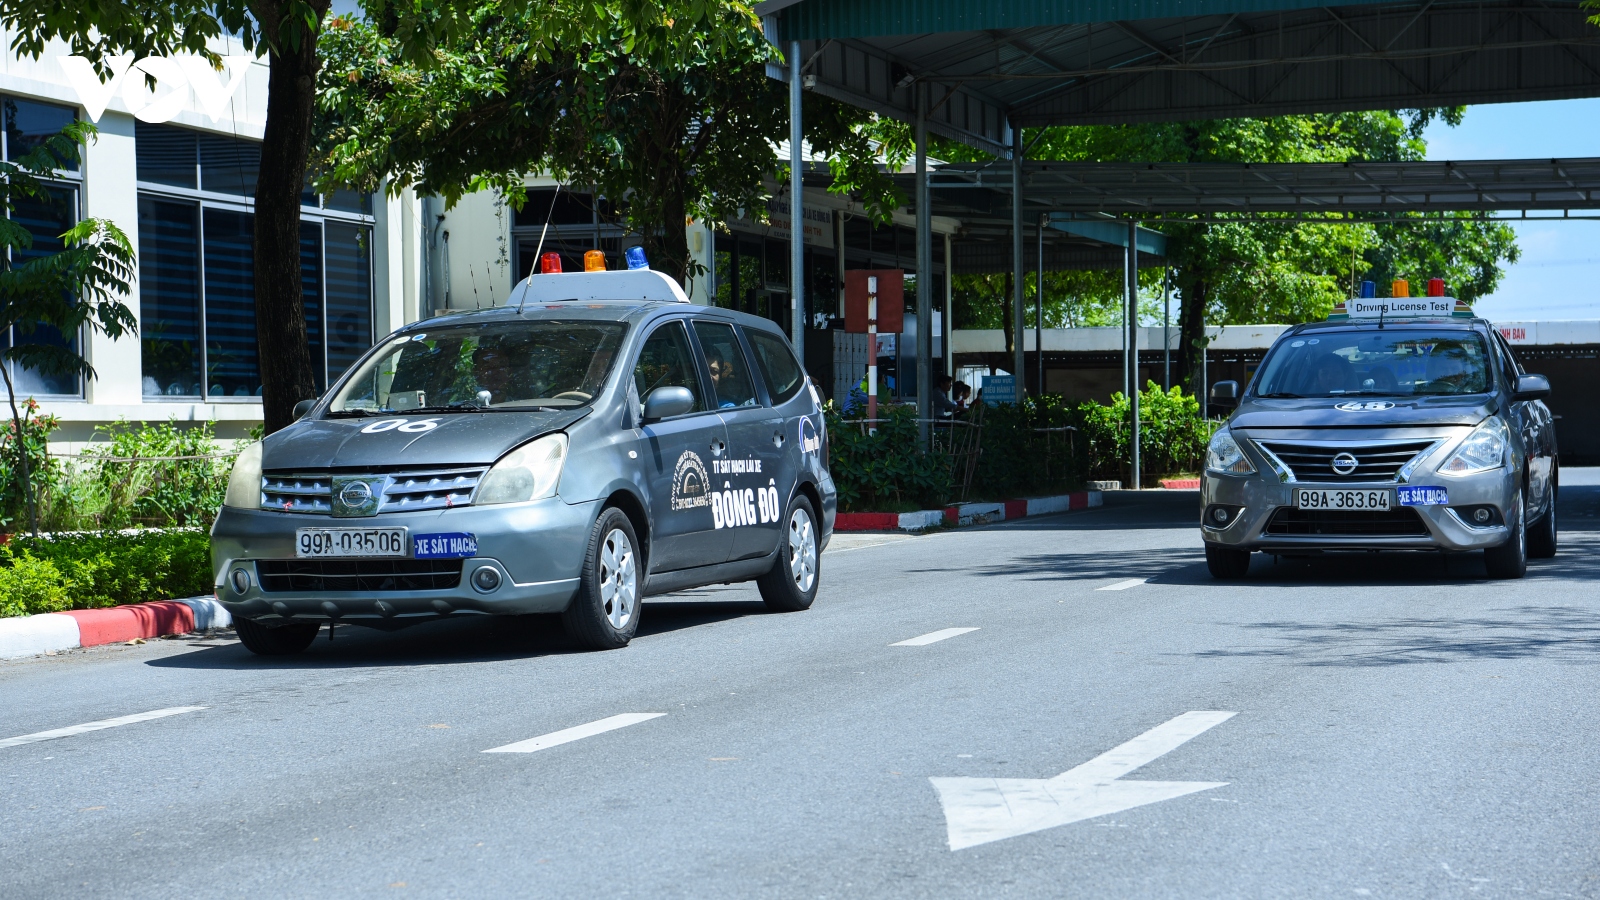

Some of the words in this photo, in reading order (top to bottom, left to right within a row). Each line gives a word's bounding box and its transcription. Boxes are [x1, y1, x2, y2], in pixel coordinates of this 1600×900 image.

[1356, 303, 1388, 313] Driving
[1391, 302, 1427, 311] License
[1429, 302, 1449, 311] Test
[1342, 401, 1387, 411] 48
[361, 418, 443, 433] 06
[712, 460, 719, 474] TT
[720, 455, 731, 474] SÁT
[731, 460, 745, 477] HẠCH
[746, 454, 755, 473] LÁI
[755, 460, 762, 473] XE
[1300, 491, 1388, 508] 99A-363.64
[1400, 491, 1410, 503] XE
[1412, 488, 1425, 503] SÁT
[711, 481, 757, 530] ĐÔNG
[758, 478, 780, 524] ĐÔ
[417, 539, 429, 555] XE
[431, 536, 448, 554] SÁT
